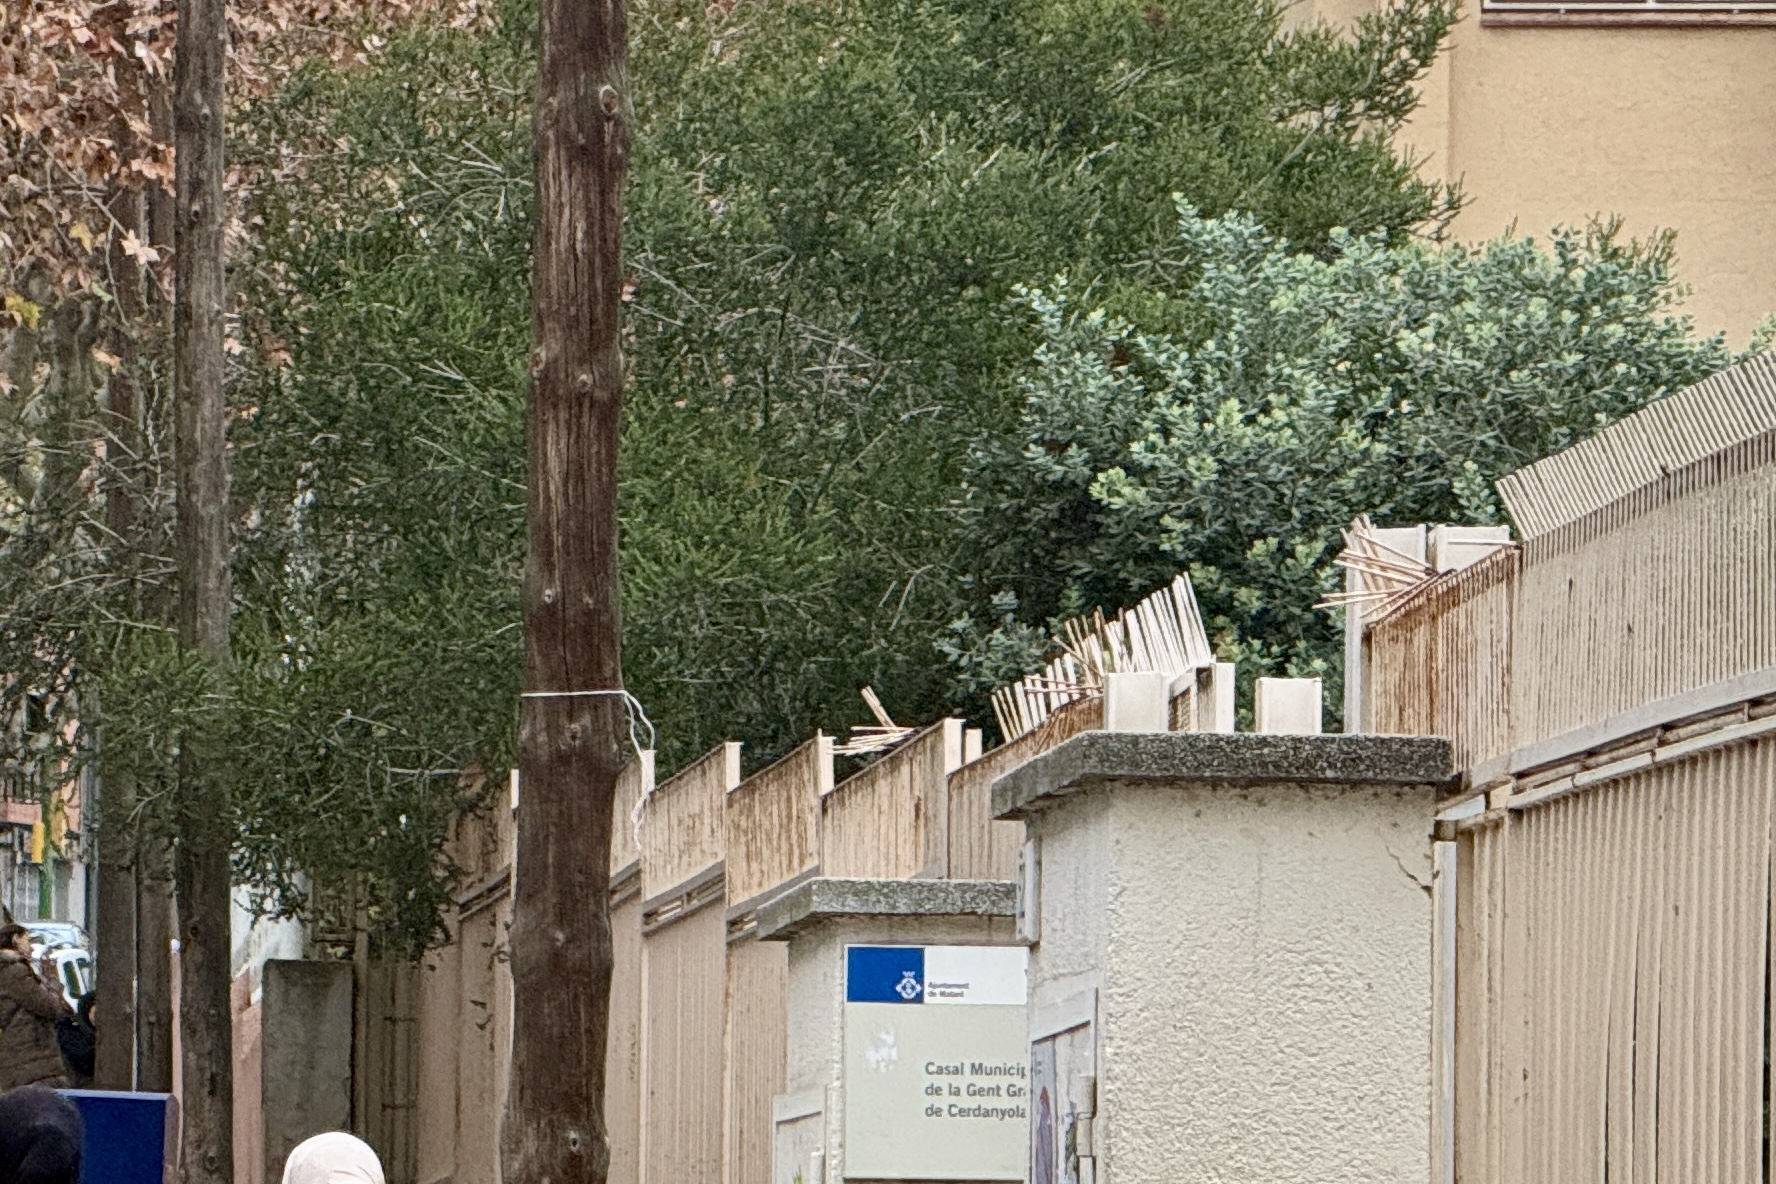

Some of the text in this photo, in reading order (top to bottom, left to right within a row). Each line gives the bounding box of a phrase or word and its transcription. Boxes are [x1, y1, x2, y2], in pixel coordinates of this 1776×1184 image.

[925, 1062, 964, 1076] Casal
[925, 1082, 1026, 1097] de la Gent Gr
[925, 1103, 943, 1117] de
